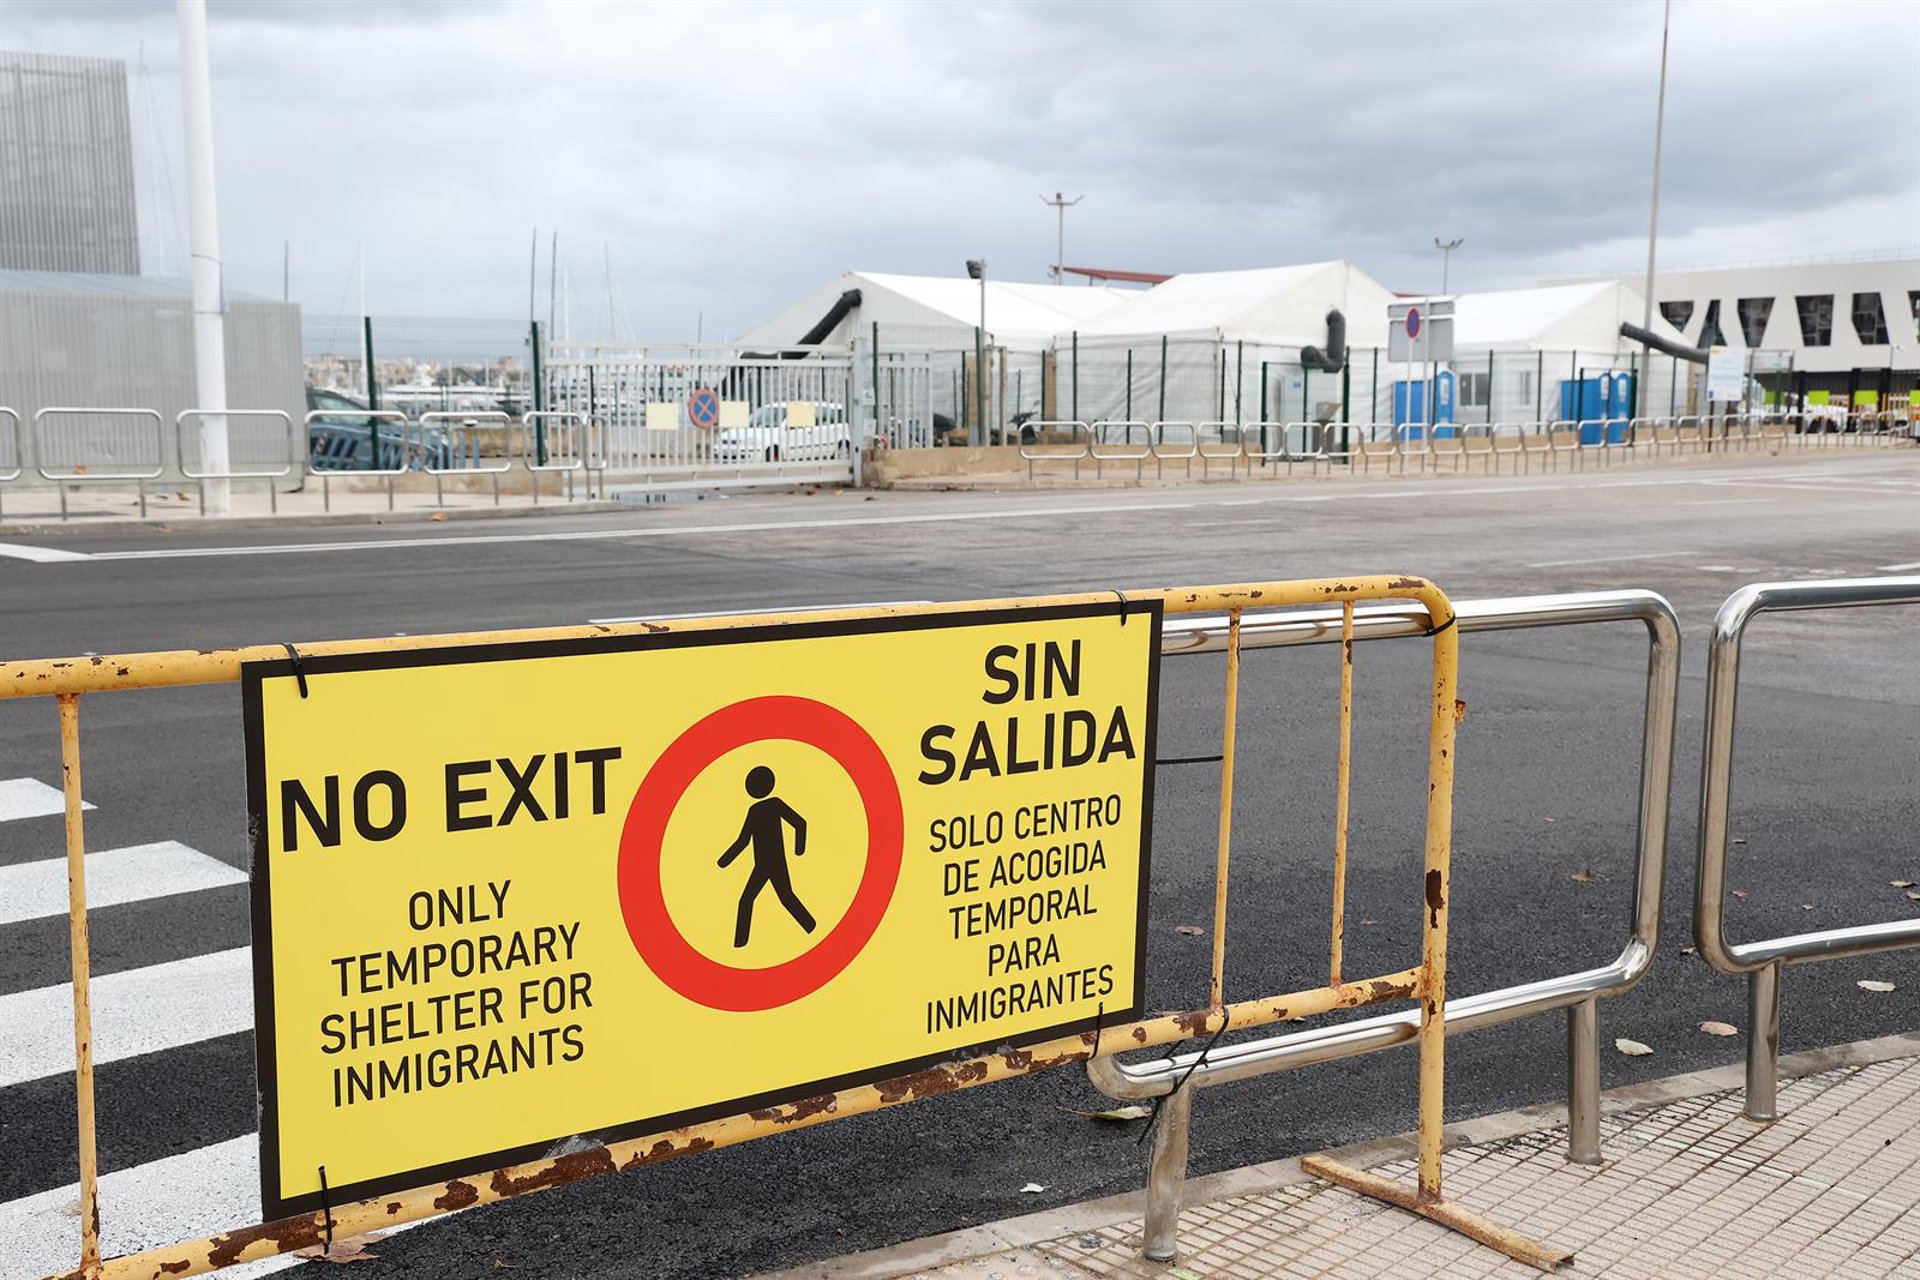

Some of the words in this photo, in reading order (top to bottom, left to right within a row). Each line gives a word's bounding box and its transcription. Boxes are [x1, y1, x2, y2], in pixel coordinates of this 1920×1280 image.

[982, 639, 1080, 704] SIN
[918, 706, 1135, 785] SALIDA
[281, 770, 406, 852] NO
[445, 747, 621, 832] EXIT
[930, 811, 1003, 852] SOLO
[1015, 794, 1121, 839] CENTRO
[944, 859, 979, 896] DE
[990, 840, 1106, 888] ACOGIDA
[409, 880, 511, 930] ONLY
[949, 884, 1097, 939] TEMPORAL
[331, 922, 580, 999] TEMPORARY
[989, 934, 1060, 976] PARA
[321, 980, 503, 1054] SHELTER
[521, 970, 592, 1019] FOR
[928, 965, 1113, 1034] INMIGRANTES
[334, 1025, 583, 1107] INMIGRANTS
